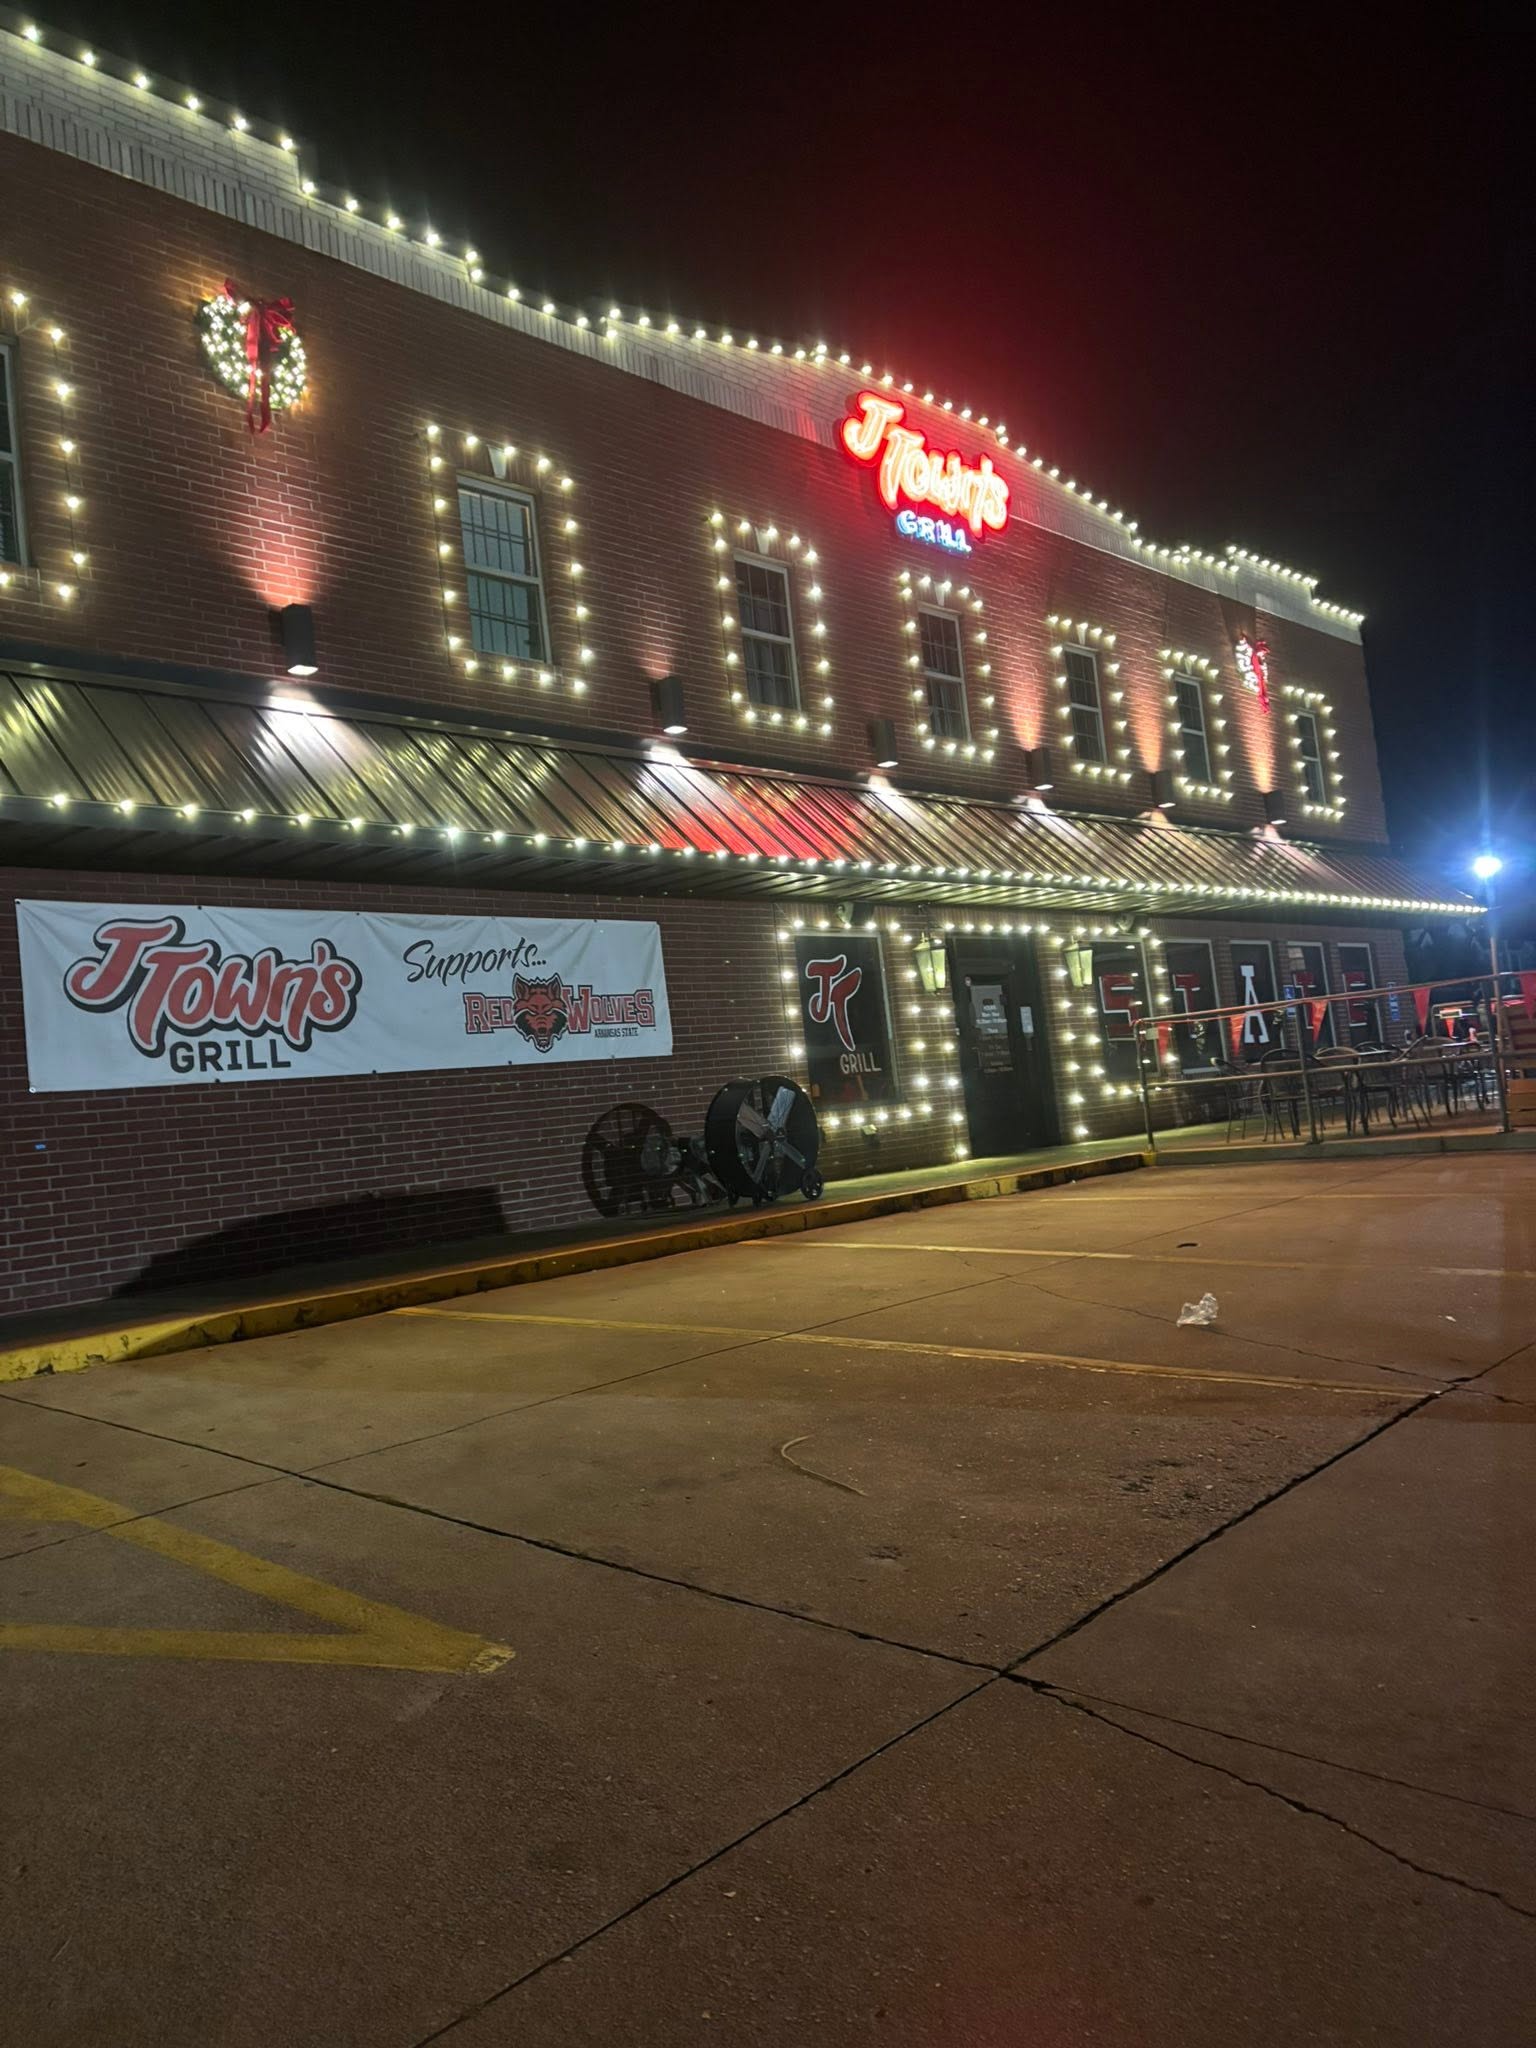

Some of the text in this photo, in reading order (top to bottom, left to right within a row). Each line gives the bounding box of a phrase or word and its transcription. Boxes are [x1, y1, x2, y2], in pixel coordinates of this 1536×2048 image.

[403, 937, 546, 986] Supports...
[463, 985, 656, 1034] RED WOLVES
[170, 1039, 291, 1073] GRILL
[840, 1051, 882, 1075] GRILL
